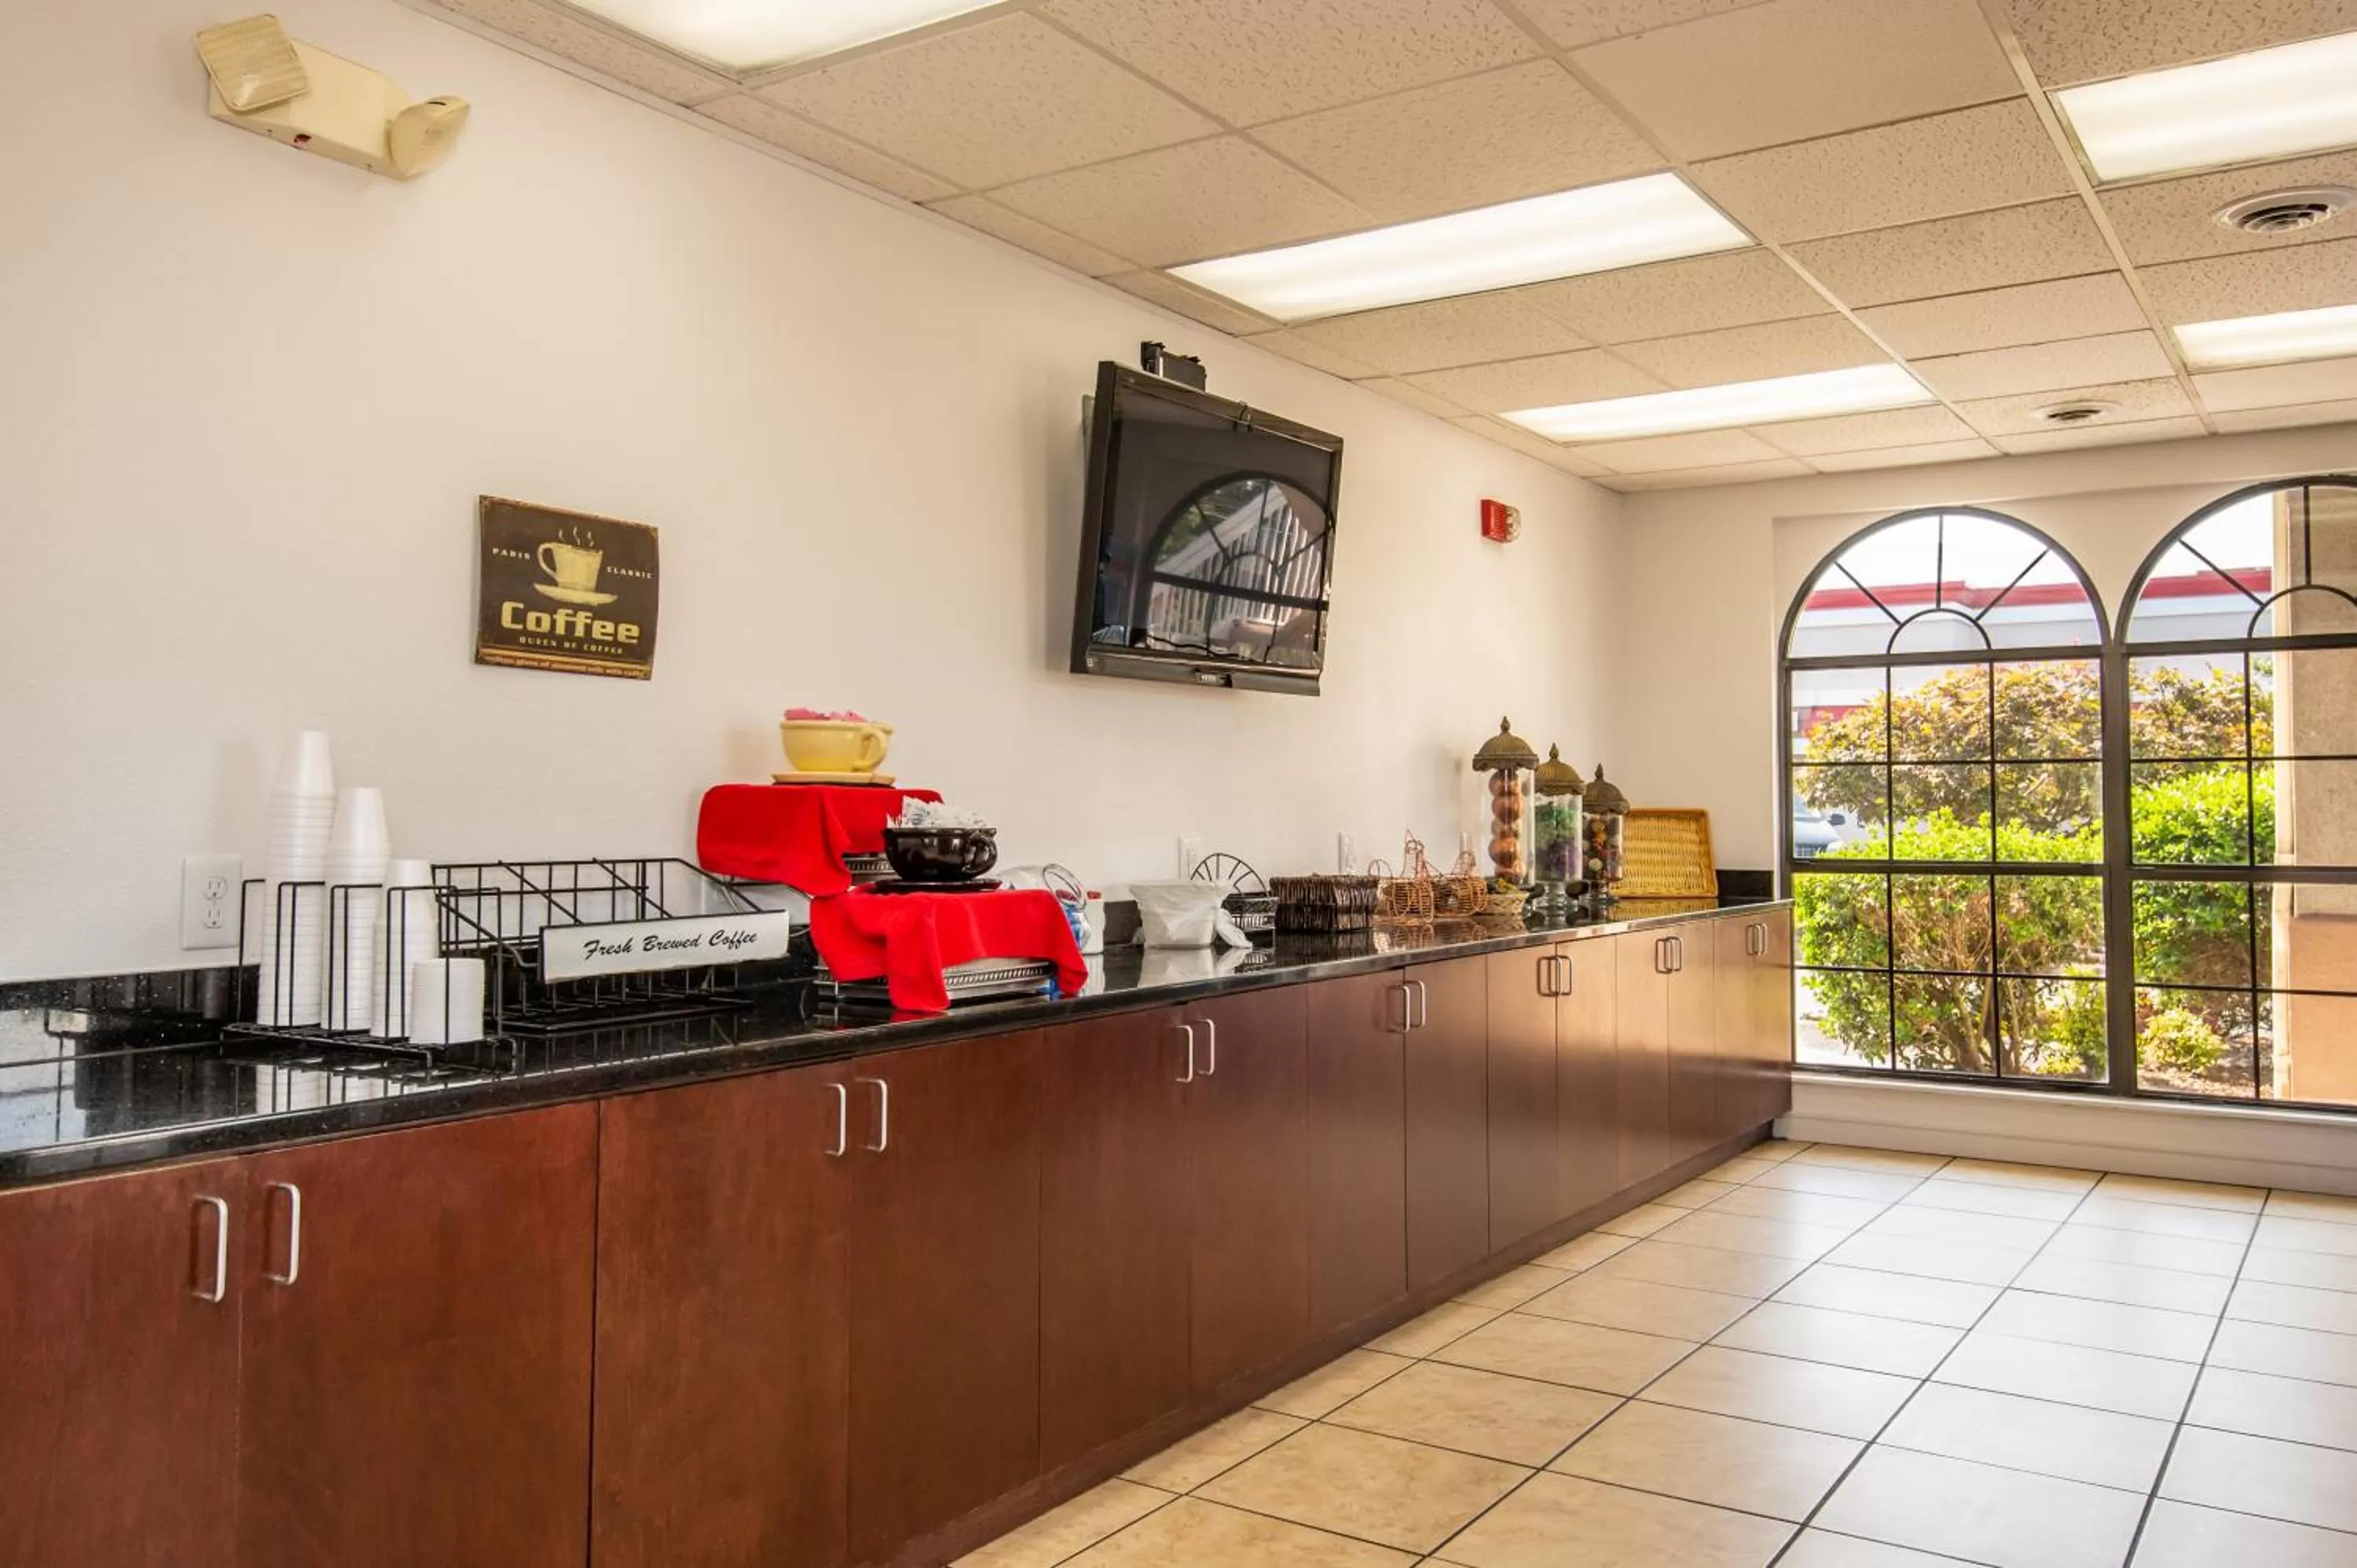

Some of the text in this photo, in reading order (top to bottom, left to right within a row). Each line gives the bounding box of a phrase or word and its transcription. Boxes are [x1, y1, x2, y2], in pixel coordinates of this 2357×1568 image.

[500, 600, 641, 644] Coffee
[519, 635, 624, 655] QUEEN OF COFFEE
[582, 929, 759, 960] Fresh Brewed Coffee
